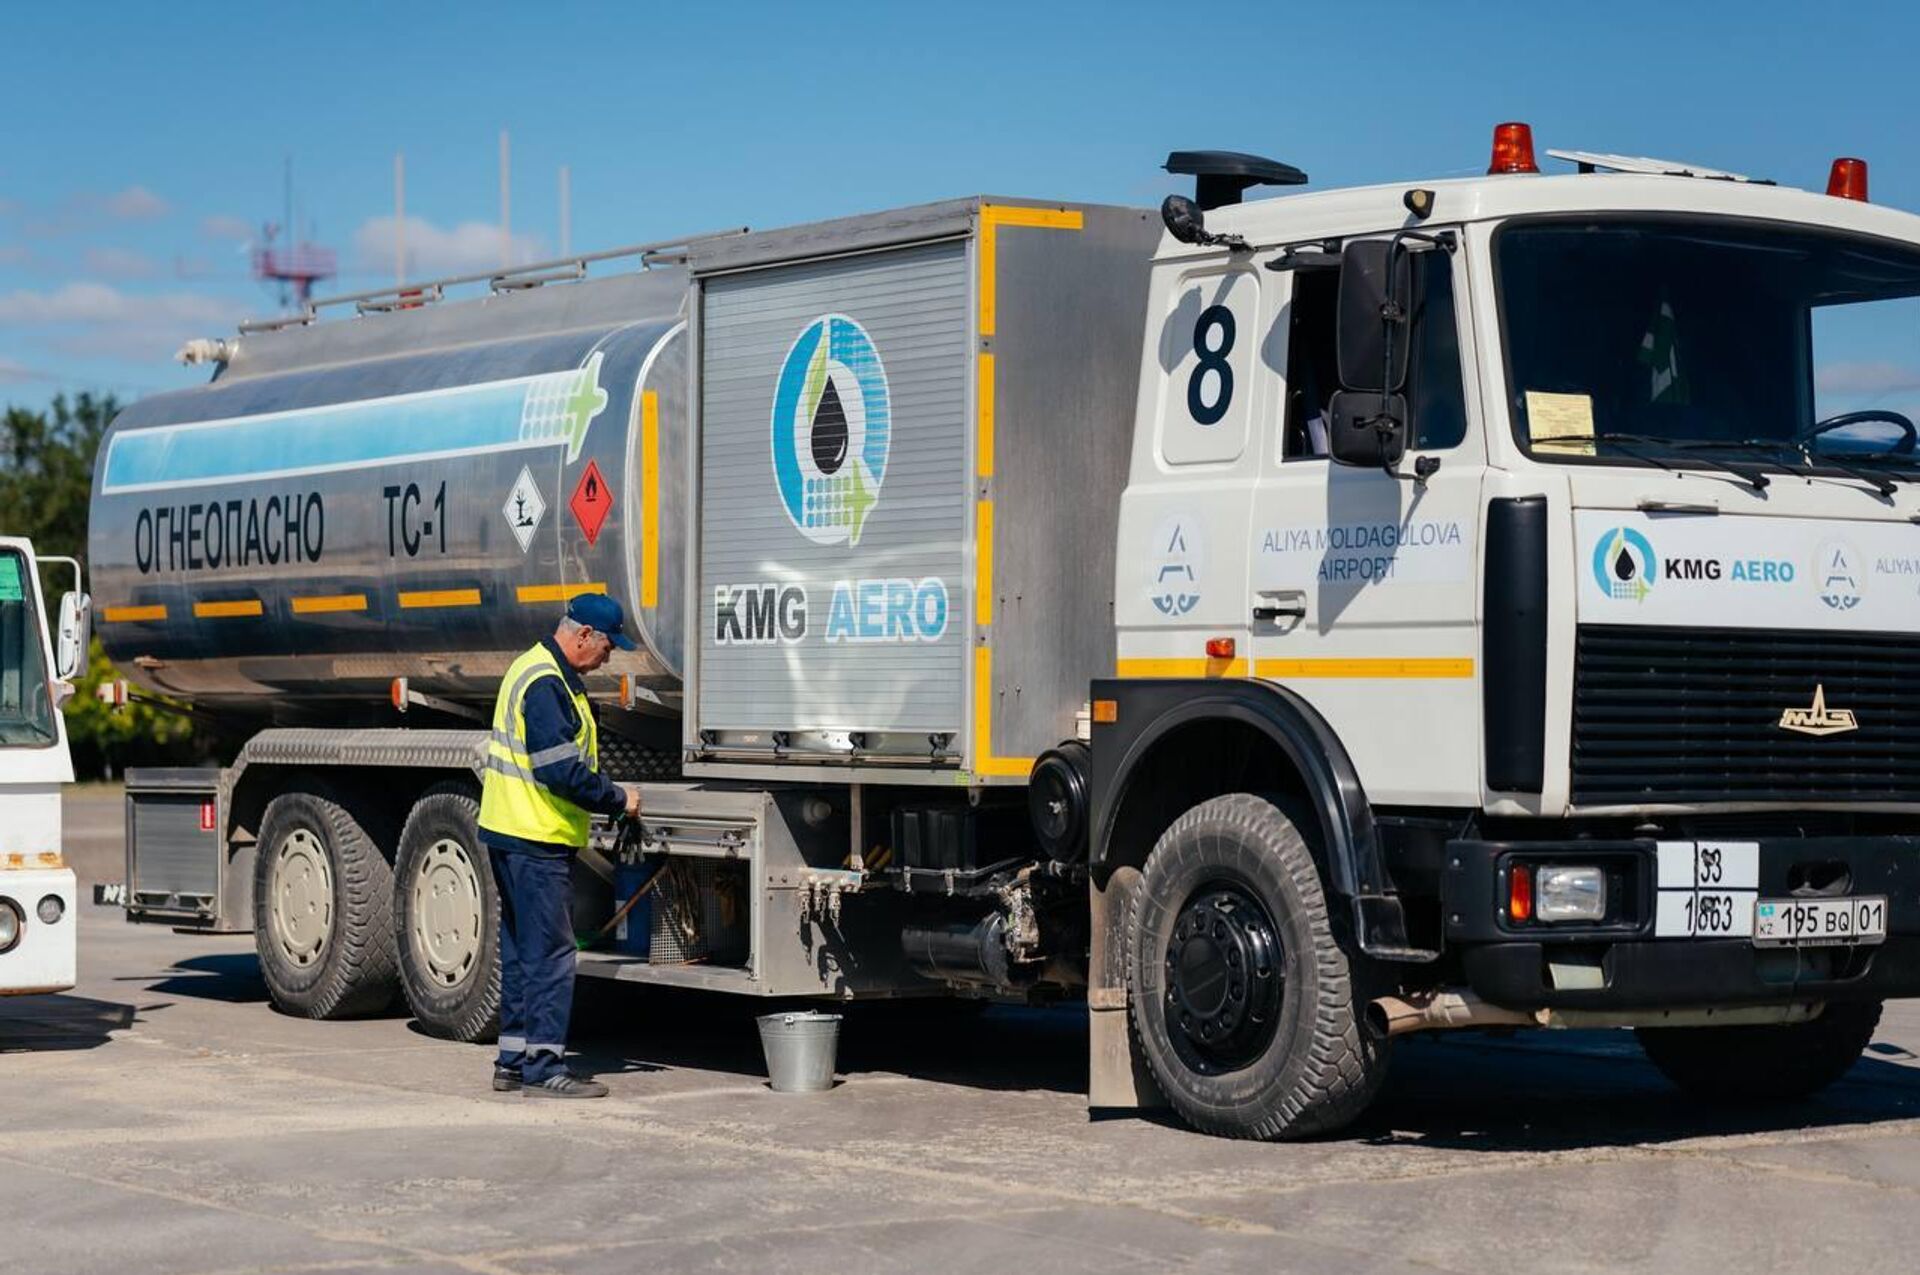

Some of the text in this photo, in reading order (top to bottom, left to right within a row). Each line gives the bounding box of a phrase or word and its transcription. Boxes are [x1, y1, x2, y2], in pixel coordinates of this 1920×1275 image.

[1187, 304, 1236, 425] 8
[135, 480, 446, 574] ОГНЕОПАСНО ТС-1
[1263, 522, 1461, 553] ALIYA MOLDAGULOVA
[1319, 556, 1399, 581] AIRPORT
[1664, 558, 1795, 583] KMG AERO
[1875, 558, 1913, 575] ALIYA
[715, 579, 949, 642] KMG AERO
[1759, 904, 1882, 935] KZ 195 BQ 01
